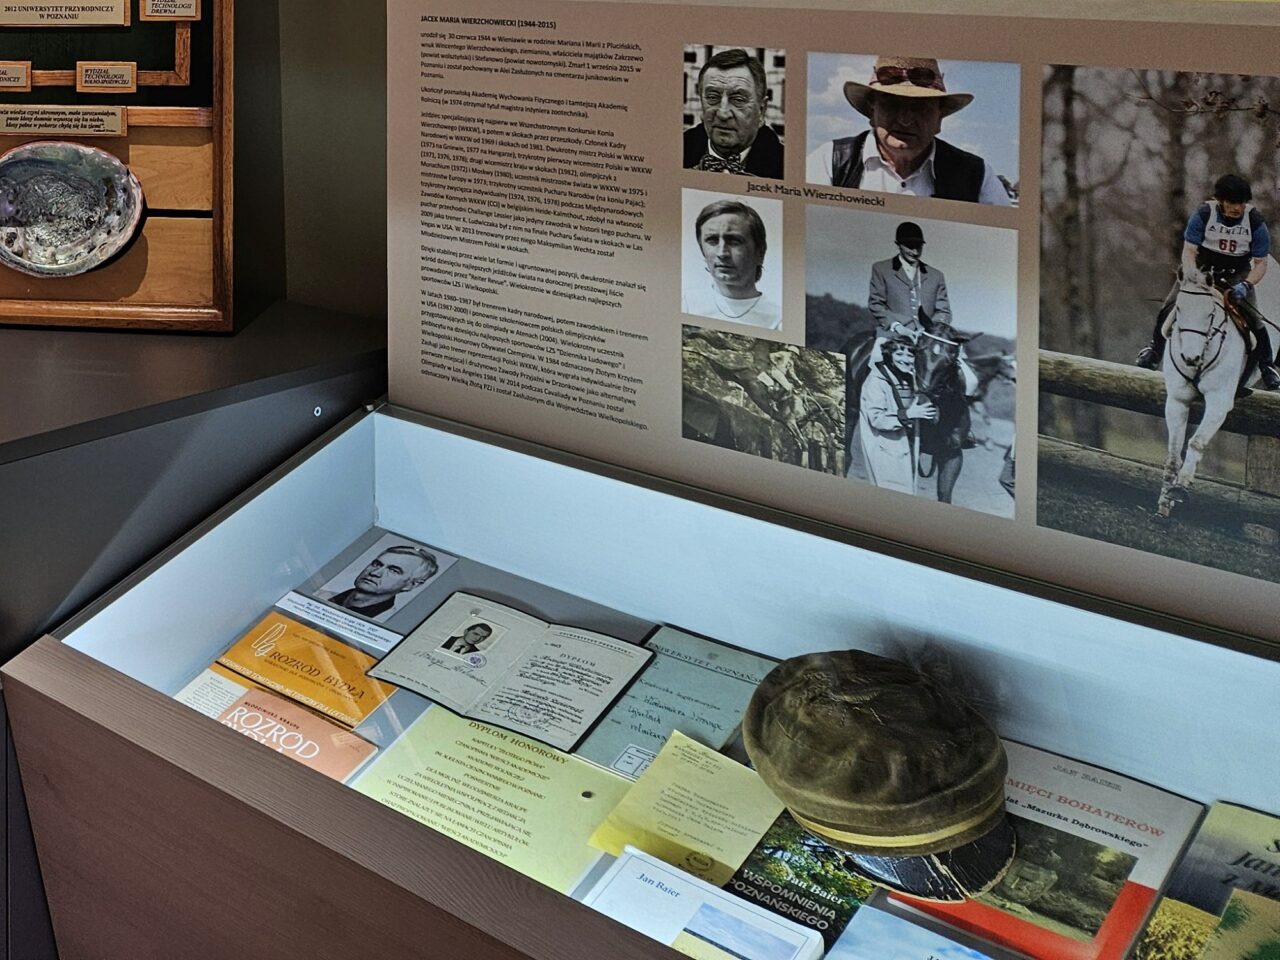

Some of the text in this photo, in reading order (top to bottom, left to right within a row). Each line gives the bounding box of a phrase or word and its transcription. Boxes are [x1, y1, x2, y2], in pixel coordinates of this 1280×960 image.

[421, 15, 438, 23] JACEK
[461, 18, 516, 27] WIERZCHOWIECKI
[518, 20, 556, 30] (1944-2015)
[747, 182, 885, 207] Jacek Maria Wierzchowiecki
[1219, 239, 1237, 252] 66
[269, 651, 365, 701] ROZRÓD BYDŁA
[226, 706, 320, 759] ROZRÓD
[468, 721, 569, 765] DYPLOM HONOROWY
[1056, 793, 1165, 839] BOHATERÓW
[636, 873, 681, 898] Jan Baier
[729, 878, 829, 931] POZNAŃSKIEGO
[742, 869, 836, 920] WSPOMNIENIA
[786, 874, 846, 906] Jan Baier
